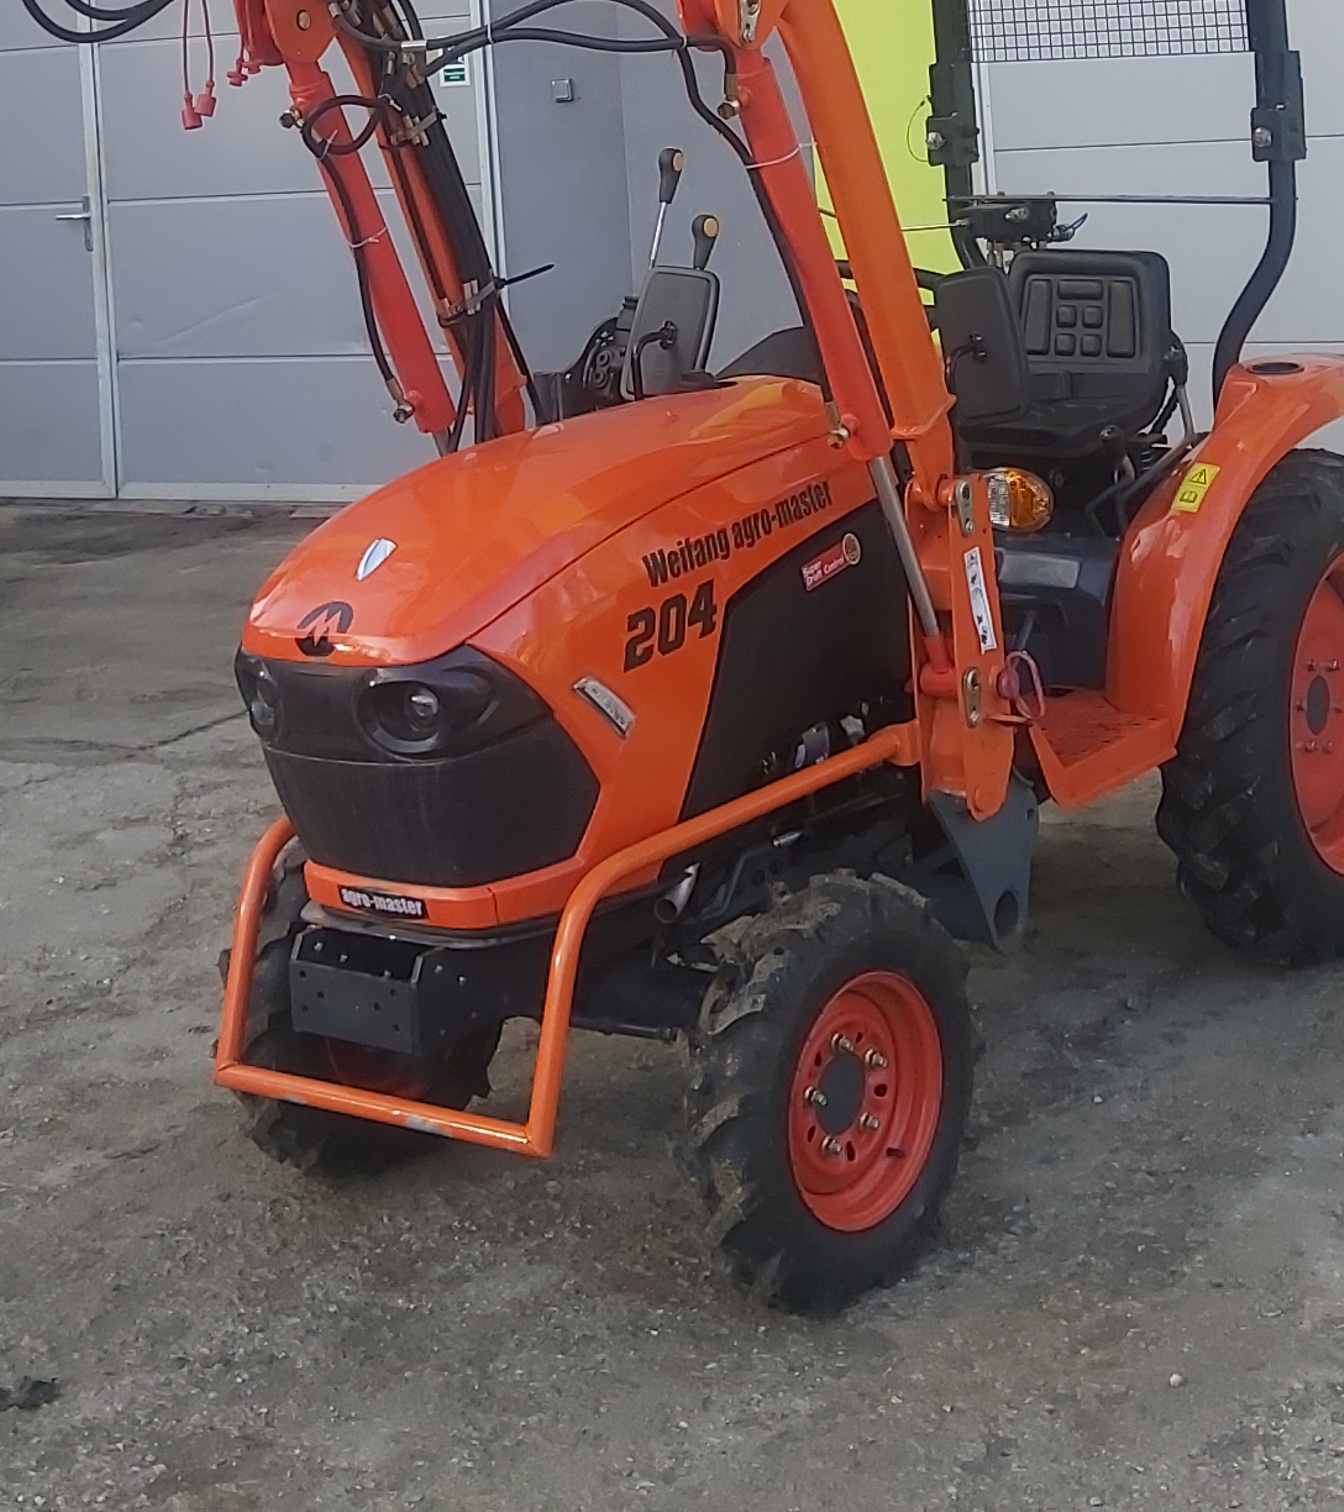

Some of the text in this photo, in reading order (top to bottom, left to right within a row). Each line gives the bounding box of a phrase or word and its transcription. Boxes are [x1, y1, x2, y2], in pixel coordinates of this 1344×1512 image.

[642, 481, 833, 587] Weifang agro-master
[623, 578, 717, 672] 204
[341, 888, 423, 916] agro-master
